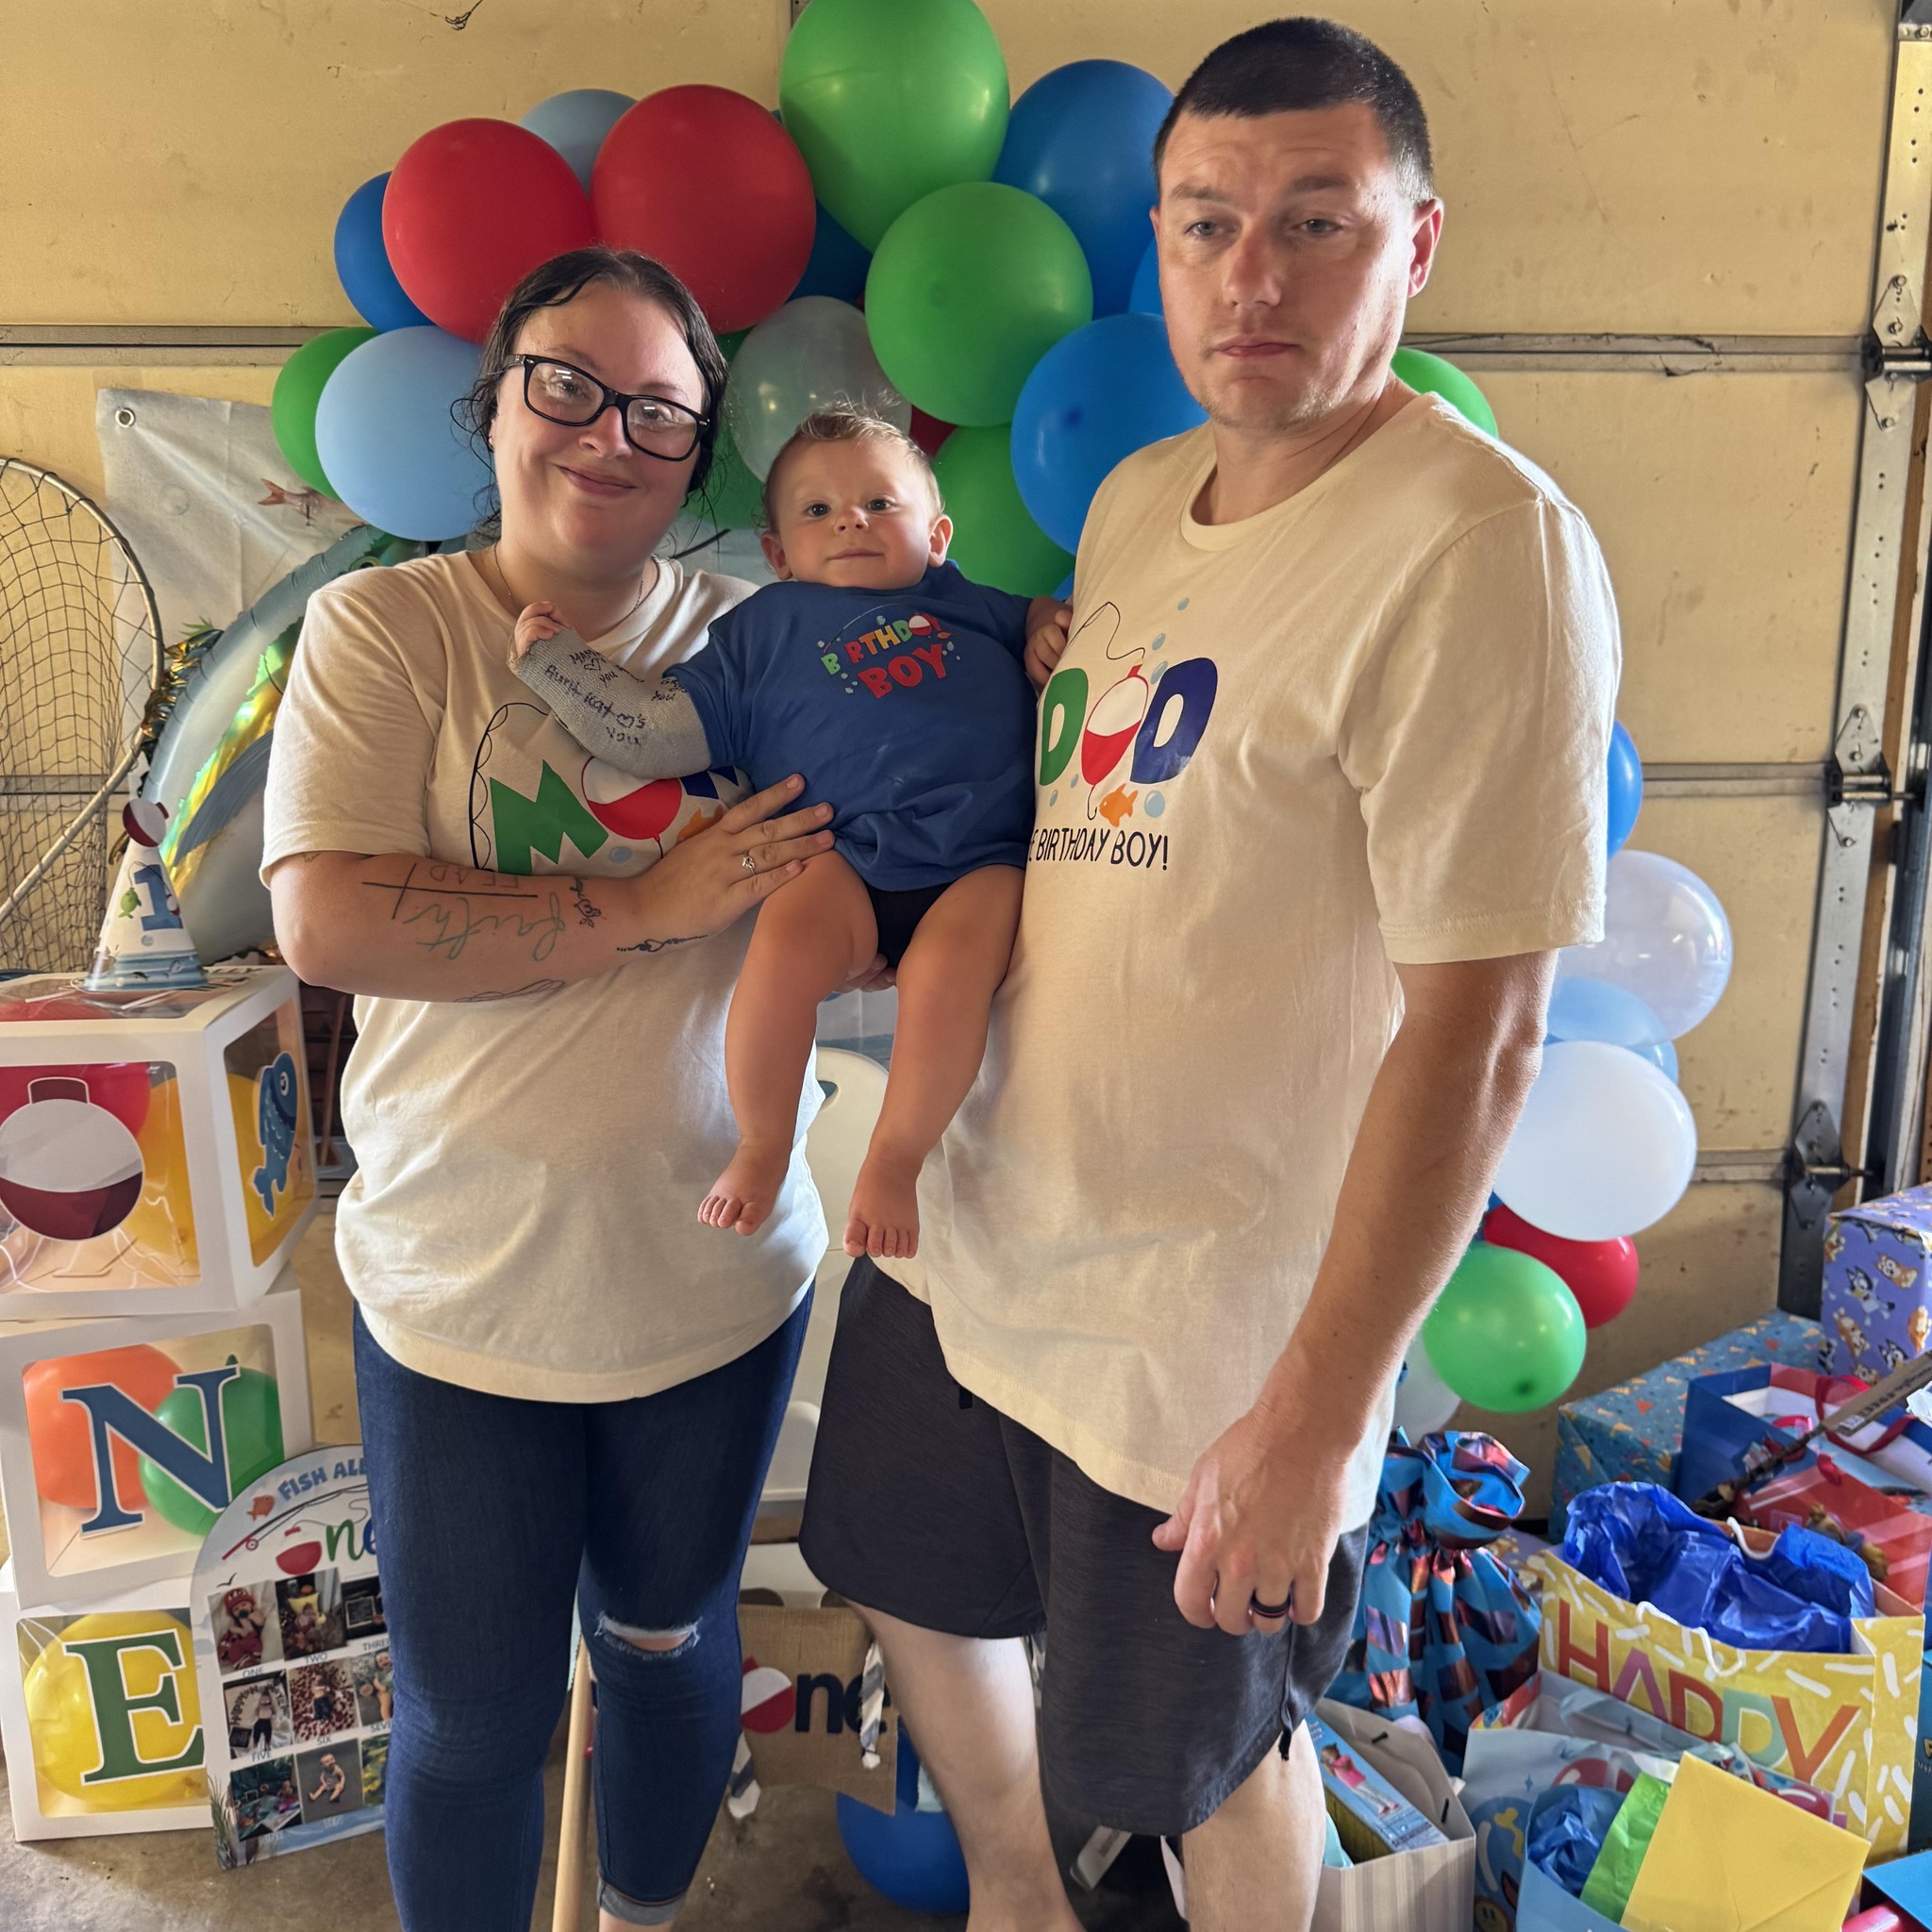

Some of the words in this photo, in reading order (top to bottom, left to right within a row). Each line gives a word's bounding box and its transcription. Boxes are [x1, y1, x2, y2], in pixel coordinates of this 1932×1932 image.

[857, 643, 947, 699] BOY
[1035, 827, 1111, 862] BIRTHDAY
[1110, 829, 1169, 871] BOY!
[59, 1364, 241, 1539] N
[277, 1466, 327, 1502] FISH
[333, 1457, 367, 1480] ALL
[242, 1666, 263, 1678] ONE
[306, 1653, 328, 1664] TWO
[63, 1627, 208, 1787] E
[251, 1750, 272, 1762] FIVE
